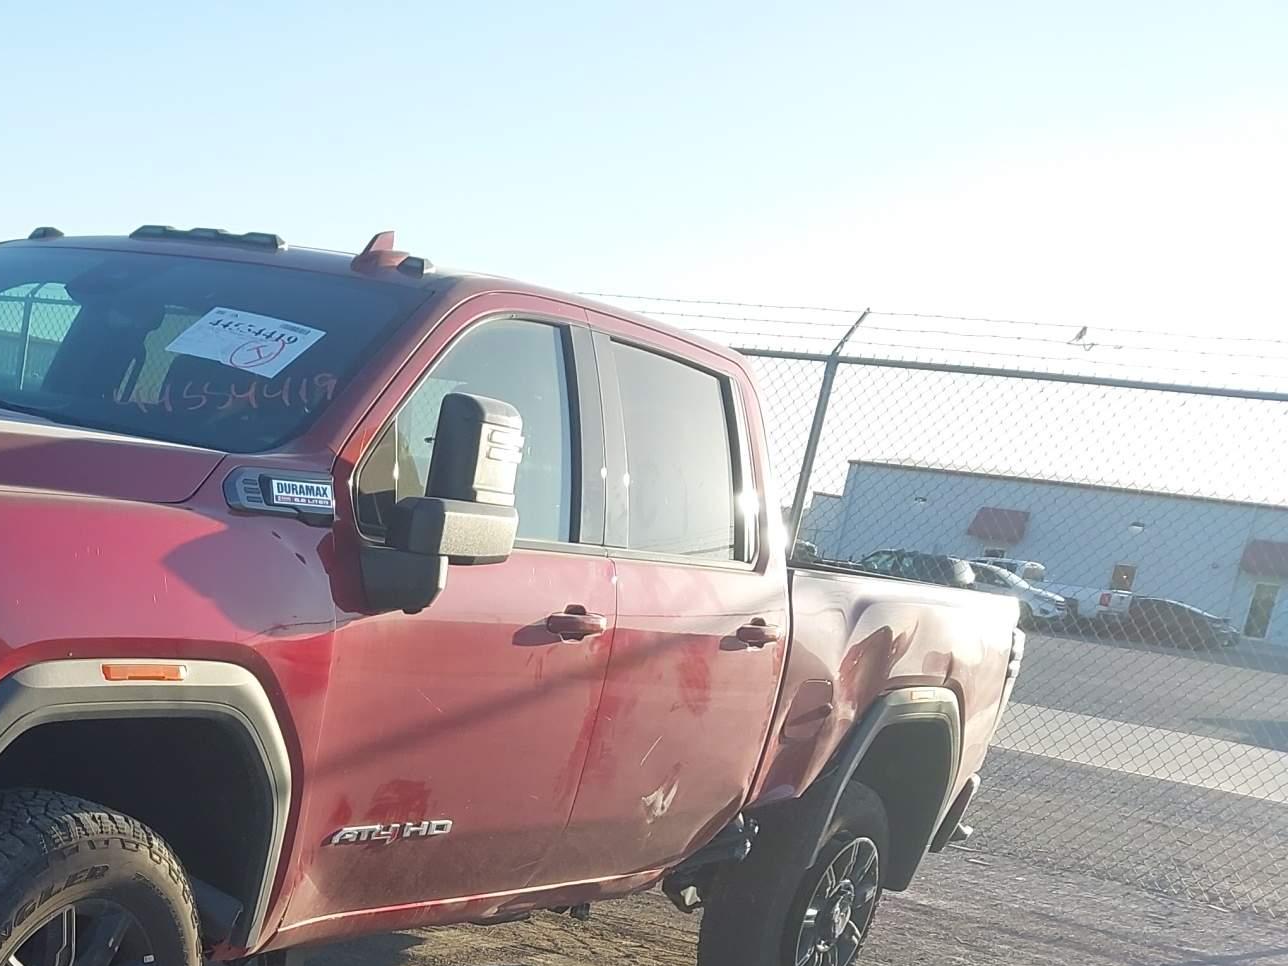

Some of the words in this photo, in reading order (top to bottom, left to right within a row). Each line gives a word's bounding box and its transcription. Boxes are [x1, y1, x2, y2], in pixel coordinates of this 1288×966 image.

[276, 482, 329, 498] DURAMAX
[307, 498, 330, 506] LITER
[331, 824, 400, 845] AT4
[401, 819, 453, 838] HD
